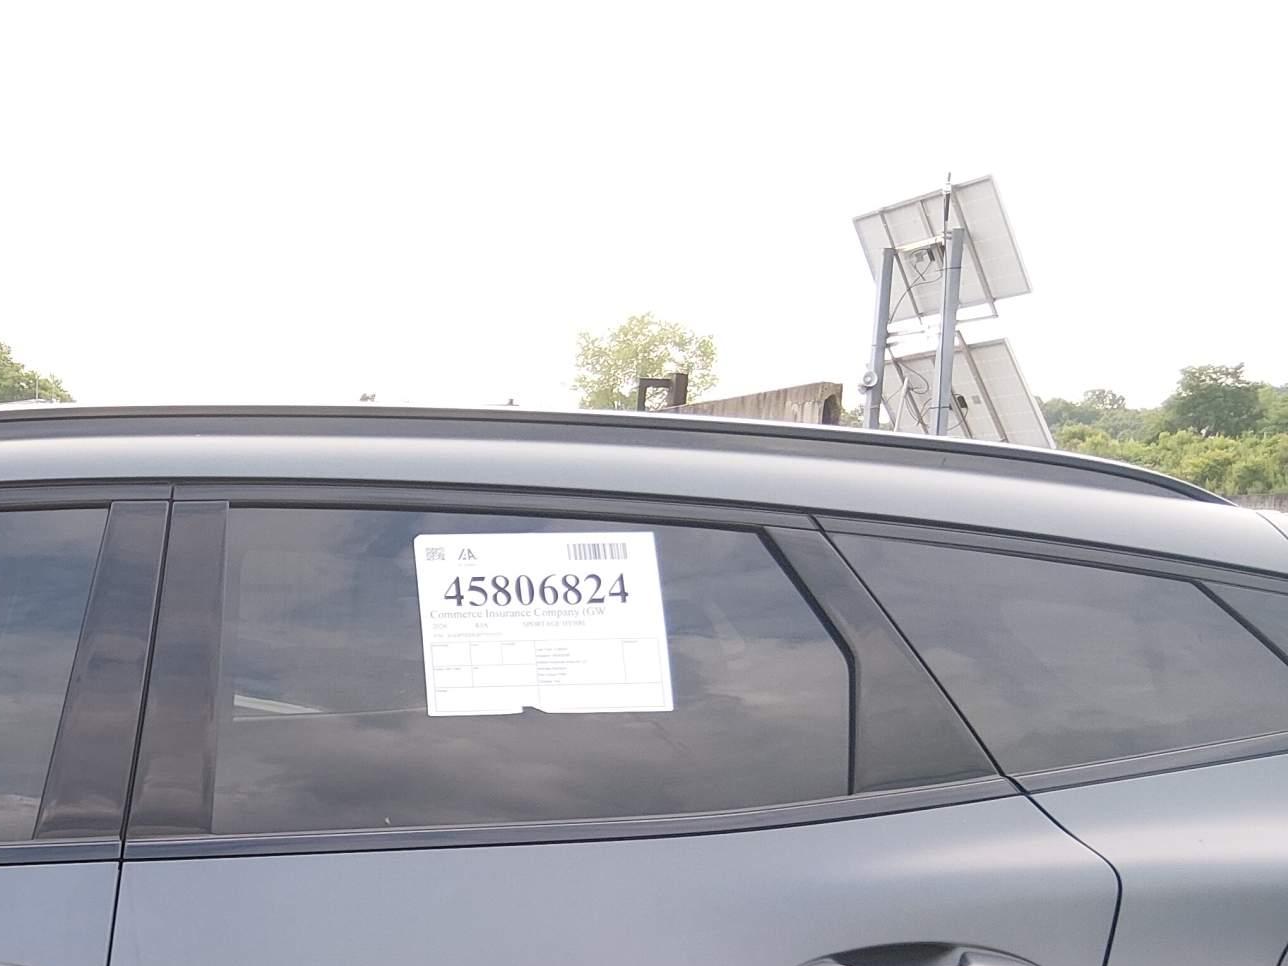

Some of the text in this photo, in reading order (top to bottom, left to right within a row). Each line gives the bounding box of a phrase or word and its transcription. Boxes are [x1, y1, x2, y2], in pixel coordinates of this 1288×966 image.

[443, 572, 630, 607] 45806824
[430, 609, 483, 619] Commerce
[485, 608, 531, 618] Insurance
[533, 607, 580, 619] Company
